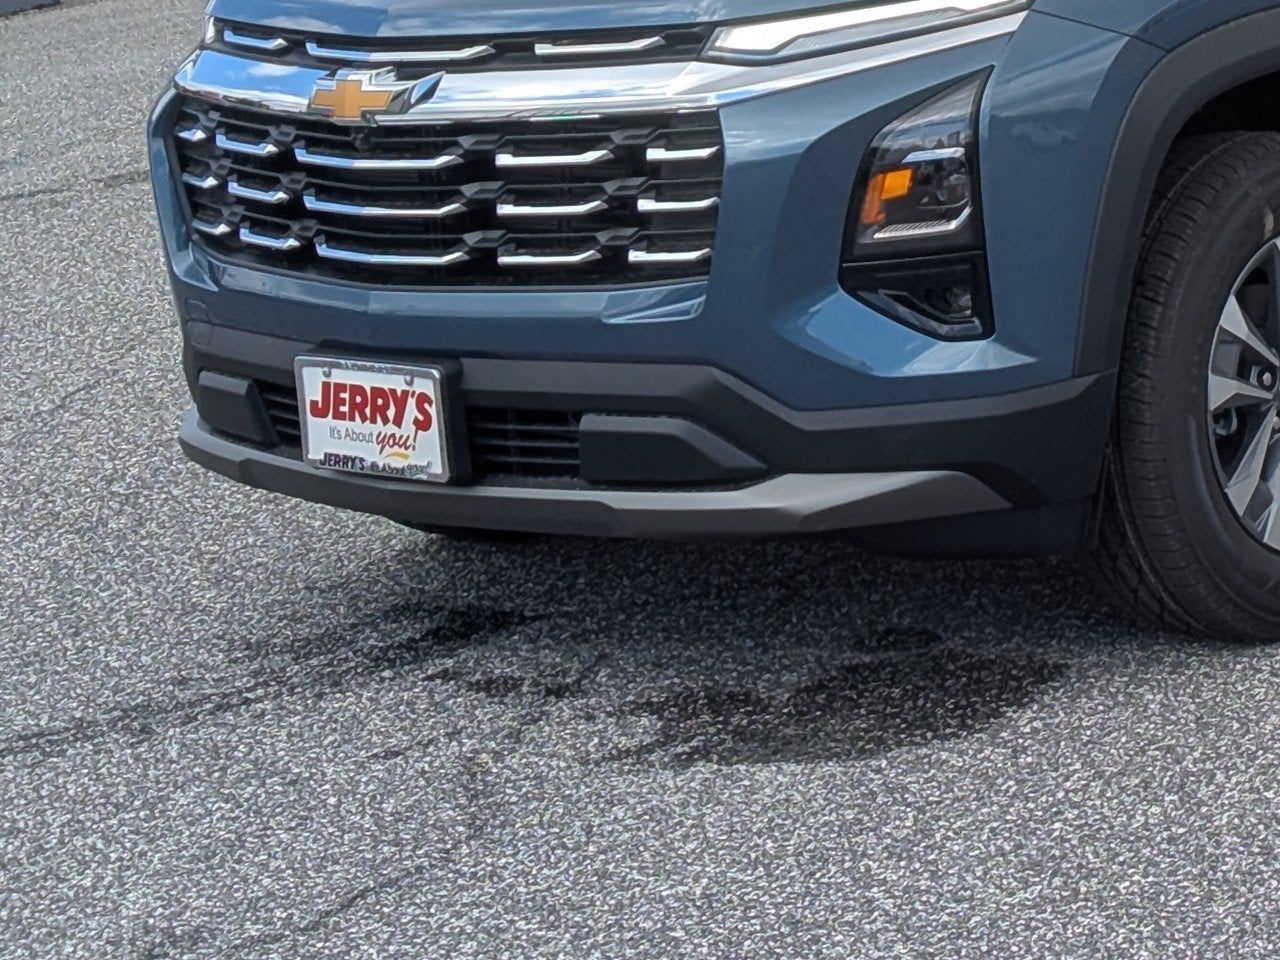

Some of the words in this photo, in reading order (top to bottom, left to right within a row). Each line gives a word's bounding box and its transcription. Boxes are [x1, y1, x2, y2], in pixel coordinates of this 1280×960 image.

[309, 380, 434, 433] JERRY'S
[329, 424, 342, 440] It's
[343, 427, 374, 444] About
[375, 425, 418, 456] you!
[318, 451, 366, 470] JERRY'S
